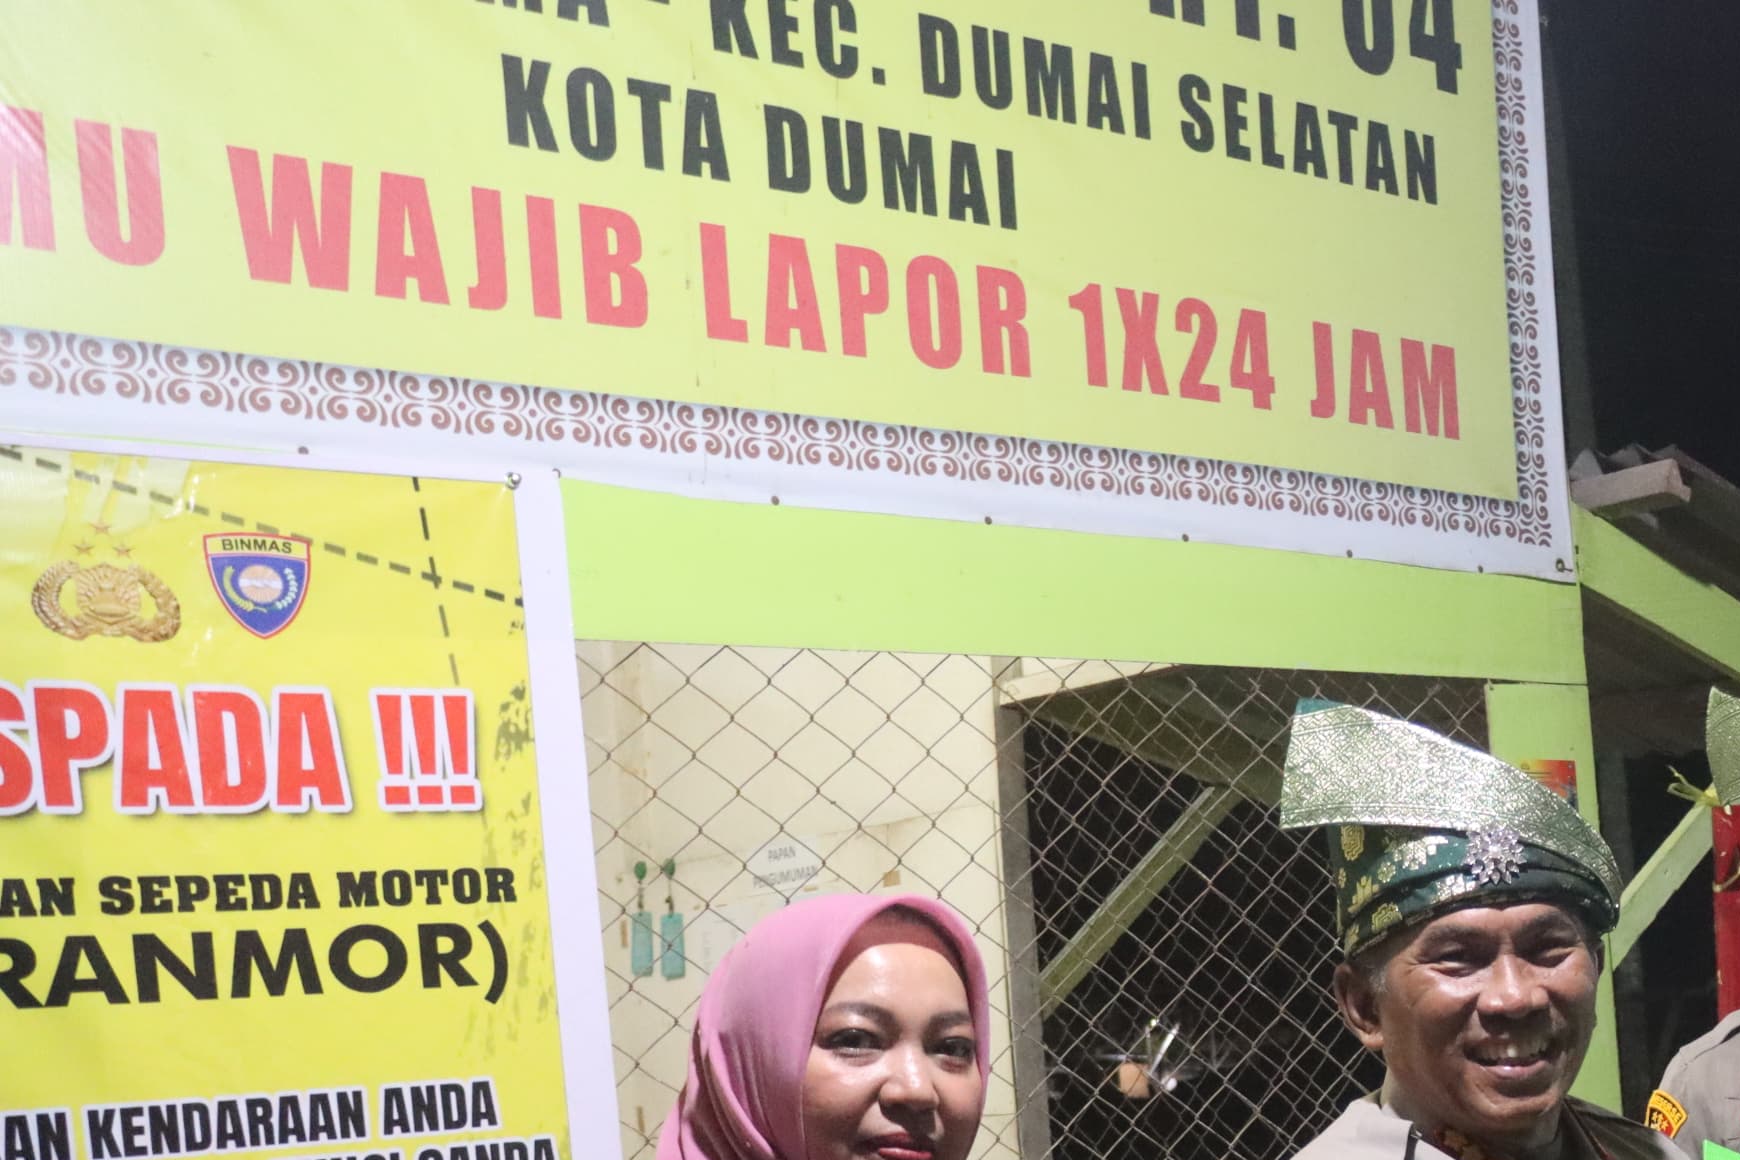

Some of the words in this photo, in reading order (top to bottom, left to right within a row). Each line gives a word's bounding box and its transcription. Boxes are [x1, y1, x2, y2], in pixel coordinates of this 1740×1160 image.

[1342, 0, 1463, 95] 04
[500, 53, 732, 183] KOTA
[763, 103, 1019, 231] DUMAI
[710, 0, 886, 86] KEC.
[917, 12, 1151, 141] DUMAI
[1178, 73, 1439, 206] SELATAN
[226, 144, 649, 329] WAJIB
[699, 221, 1032, 379] LAPOR
[1068, 281, 1276, 411] 1X24
[1309, 320, 1462, 441] JAM
[220, 538, 294, 555] BINMAS
[376, 694, 477, 806] !!!
[99, 872, 321, 916] SEPEDA
[336, 867, 518, 909] MOTOR
[768, 846, 796, 862] PAPAN
[0, 919, 509, 1009] RANMOR)
[87, 1090, 367, 1160] KENDARAAN
[382, 1080, 498, 1137] ANDA
